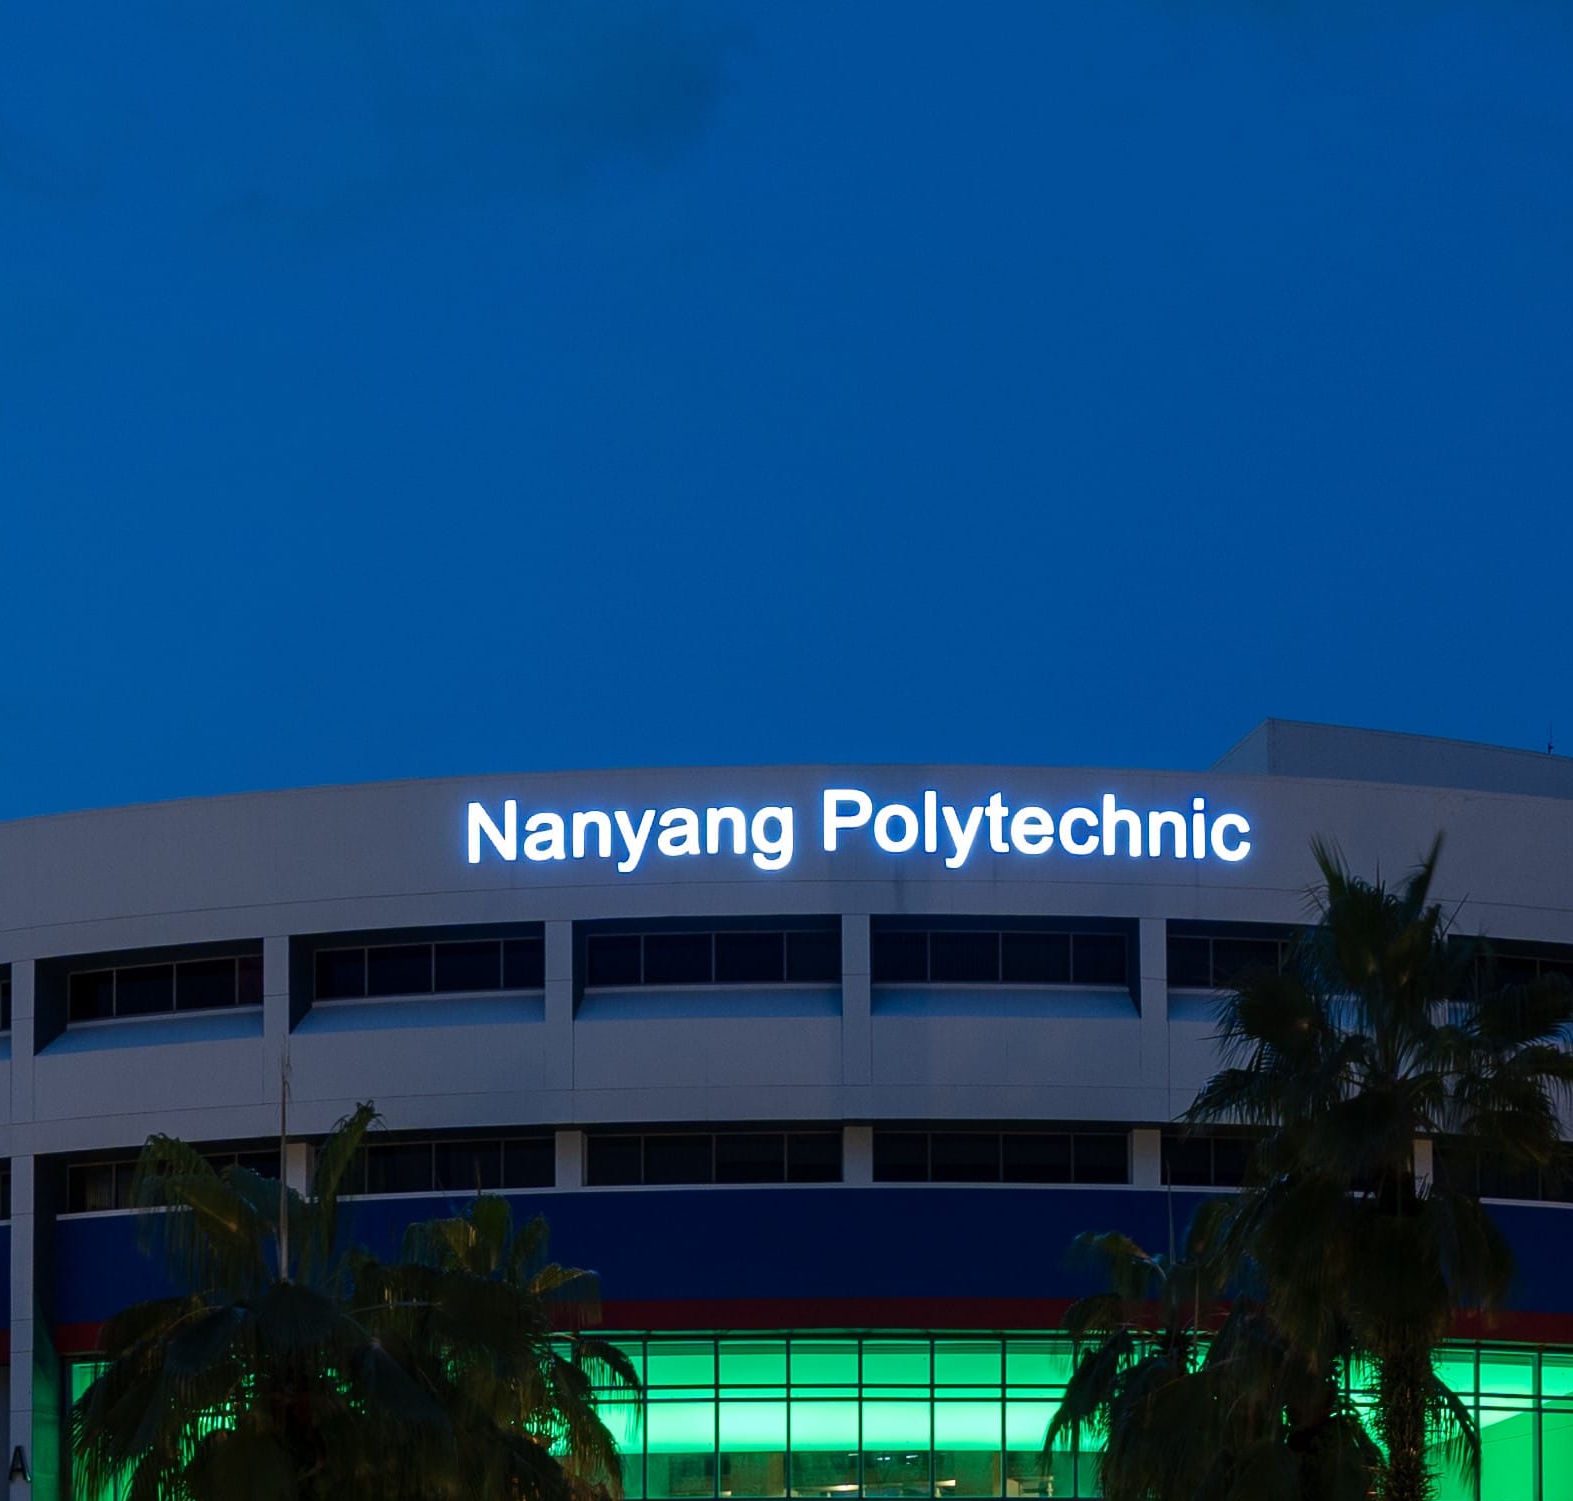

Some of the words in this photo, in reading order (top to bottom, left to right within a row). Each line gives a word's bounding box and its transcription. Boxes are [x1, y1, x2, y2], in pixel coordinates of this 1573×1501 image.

[466, 799, 794, 873] Nanyang
[823, 789, 1251, 869] Polytechnic
[9, 1446, 31, 1482] A
